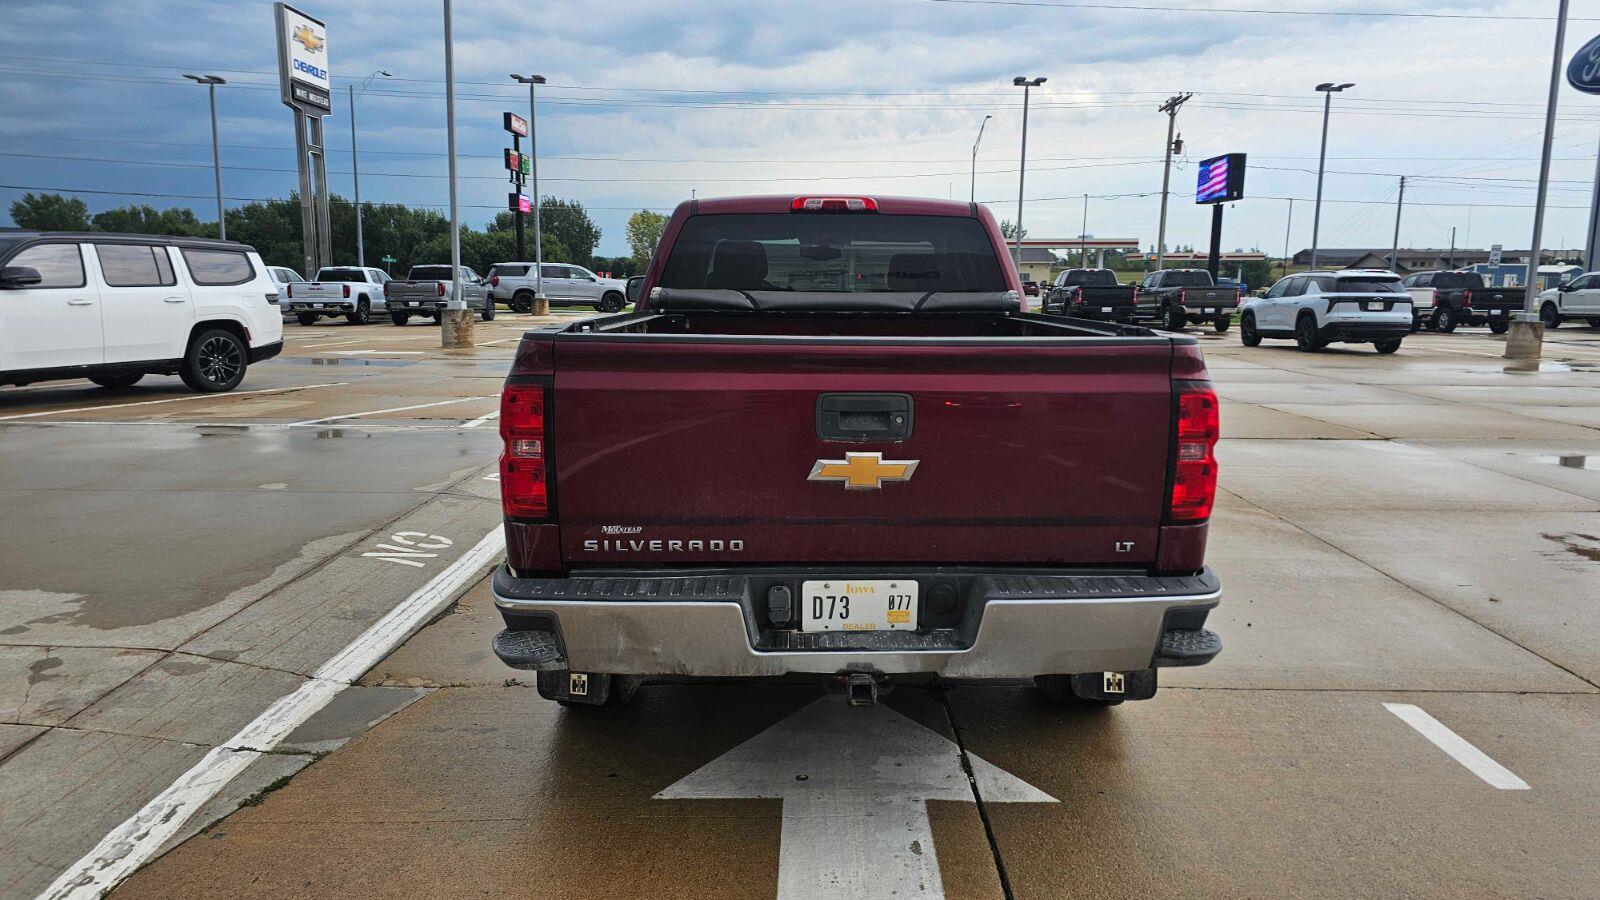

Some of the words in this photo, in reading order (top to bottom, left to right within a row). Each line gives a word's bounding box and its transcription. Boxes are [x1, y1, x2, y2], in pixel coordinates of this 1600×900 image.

[294, 59, 327, 80] CHEVROLET
[583, 539, 745, 552] SILVERADO
[1115, 541, 1135, 552] LT
[845, 583, 875, 594] IOWA
[812, 595, 850, 620] D73
[888, 595, 911, 610] 077
